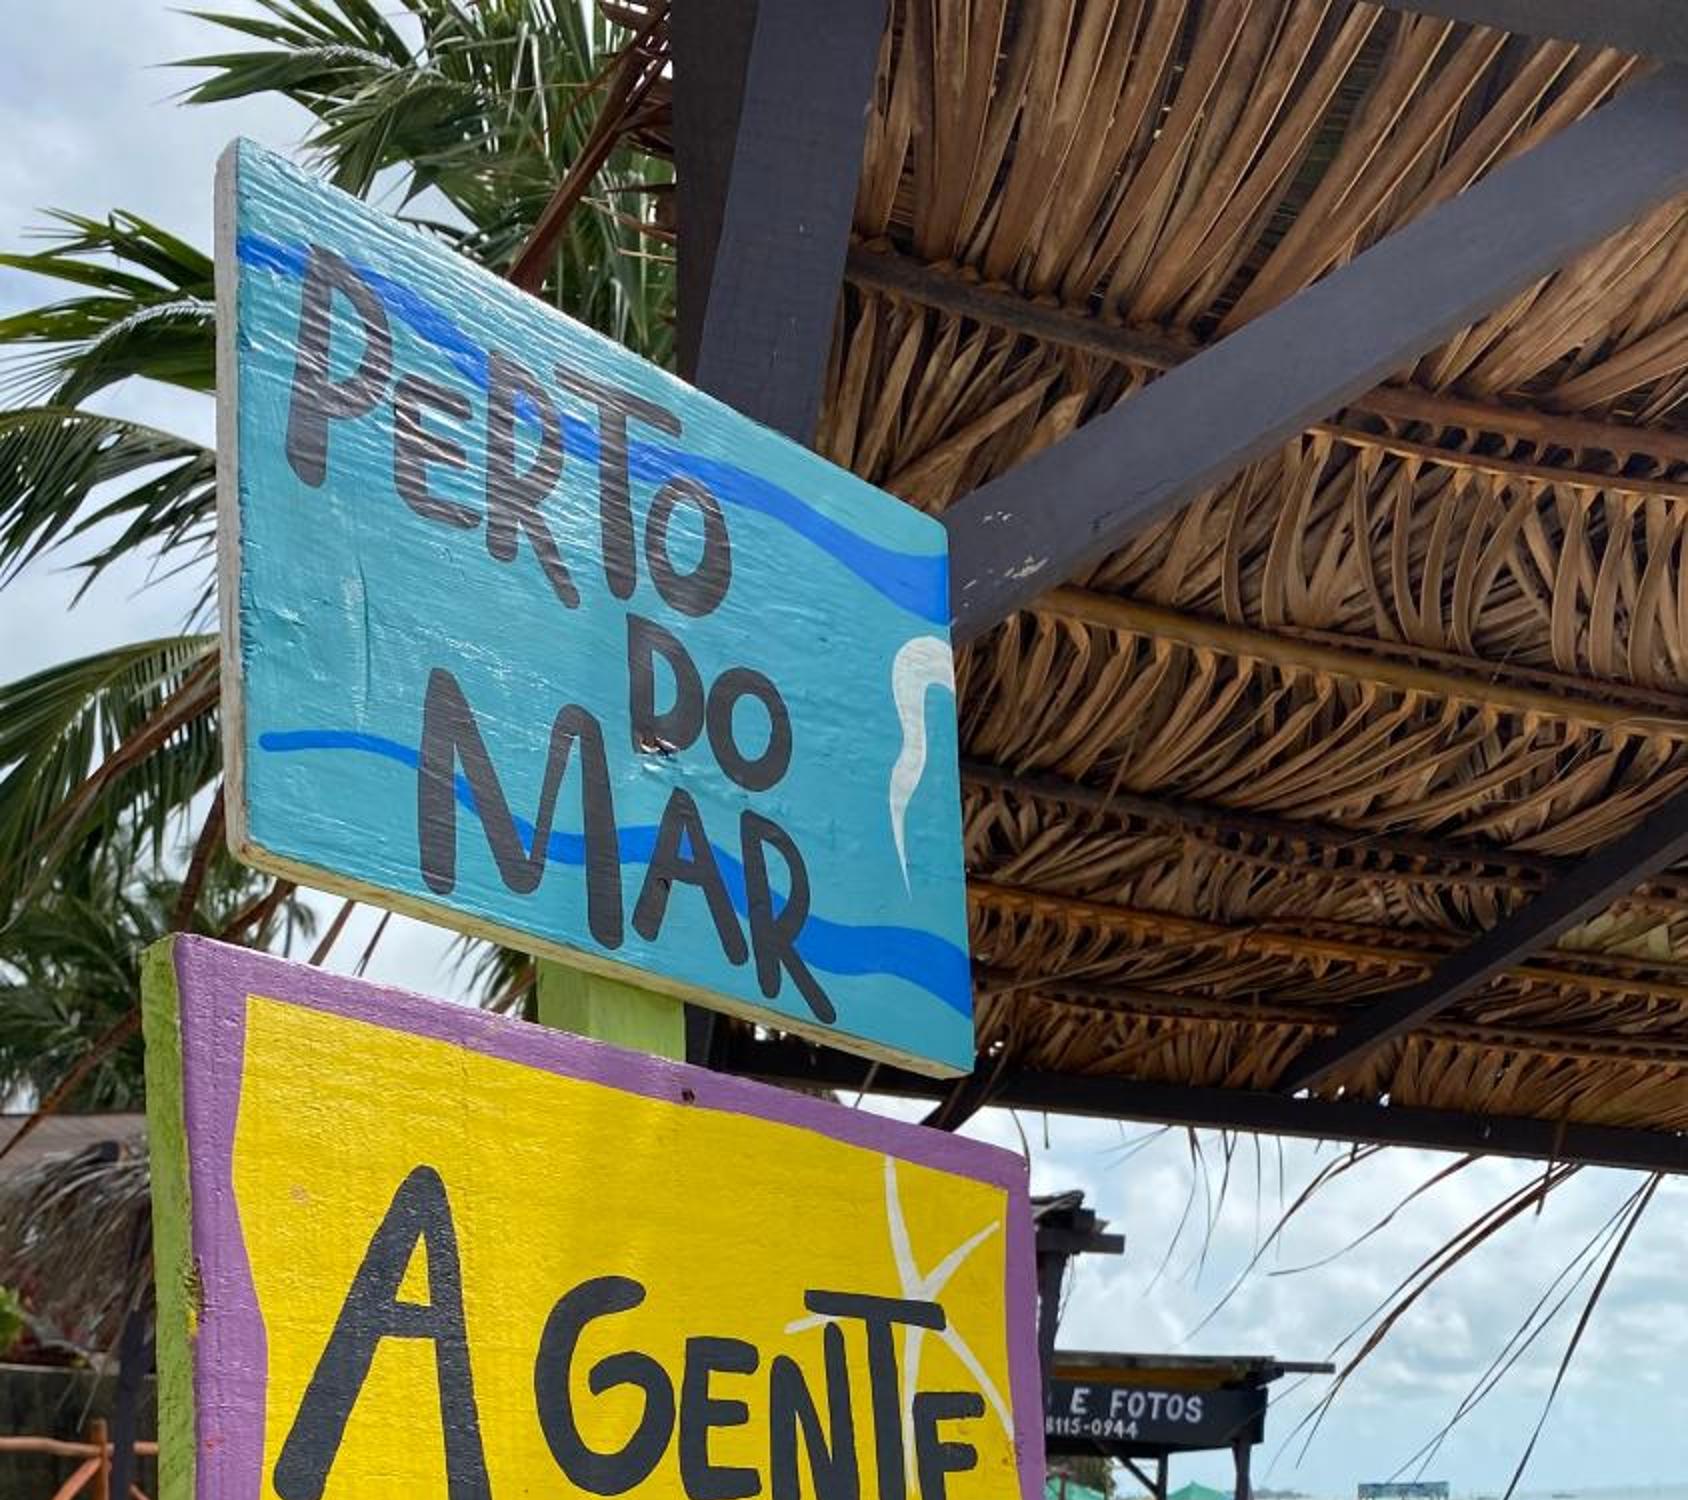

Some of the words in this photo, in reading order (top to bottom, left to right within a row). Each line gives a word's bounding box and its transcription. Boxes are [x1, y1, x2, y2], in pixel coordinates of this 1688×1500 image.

[287, 245, 731, 617] PERTO
[627, 613, 792, 791] DO
[418, 668, 838, 1024] MAR
[1070, 1387, 1090, 1414] E
[1109, 1389, 1203, 1423] FOTOS
